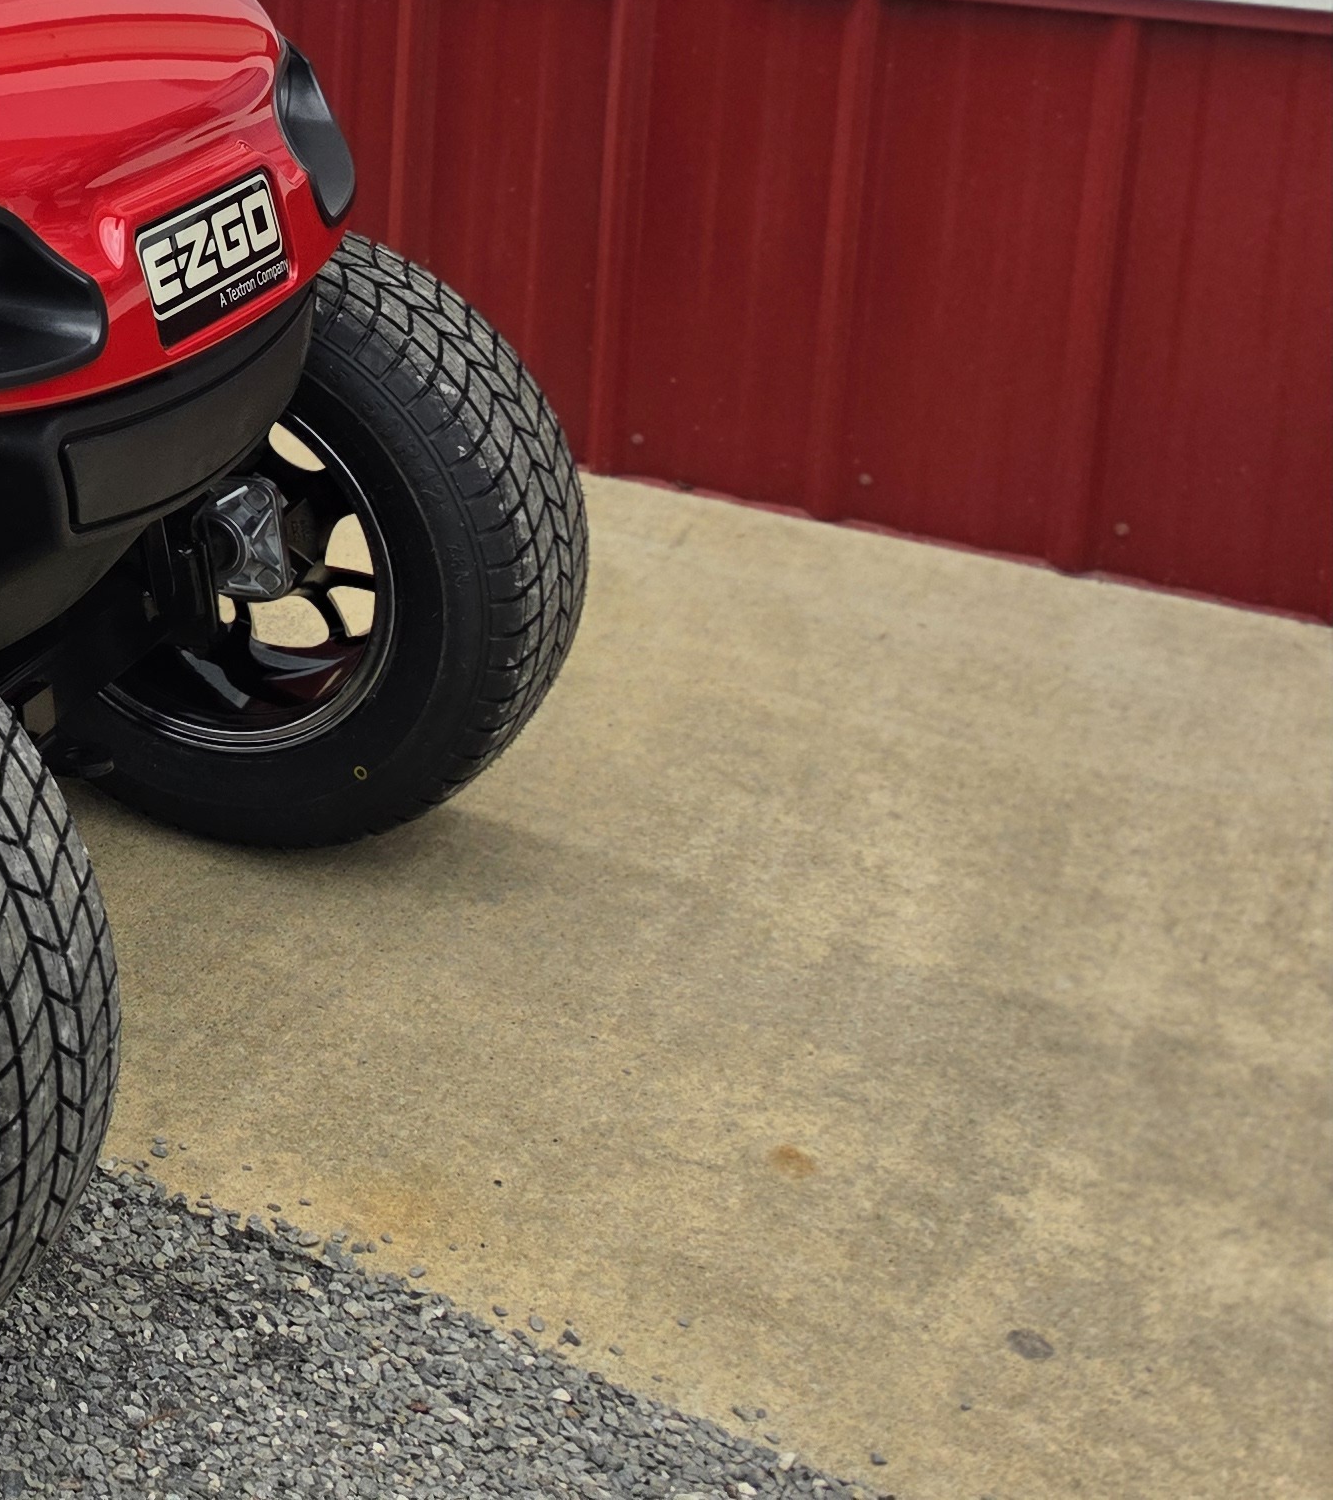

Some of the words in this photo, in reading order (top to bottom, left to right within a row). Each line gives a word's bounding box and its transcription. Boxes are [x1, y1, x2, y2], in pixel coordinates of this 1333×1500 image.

[219, 292, 228, 308] A
[226, 278, 257, 303] Textron
[256, 258, 290, 286] Company
